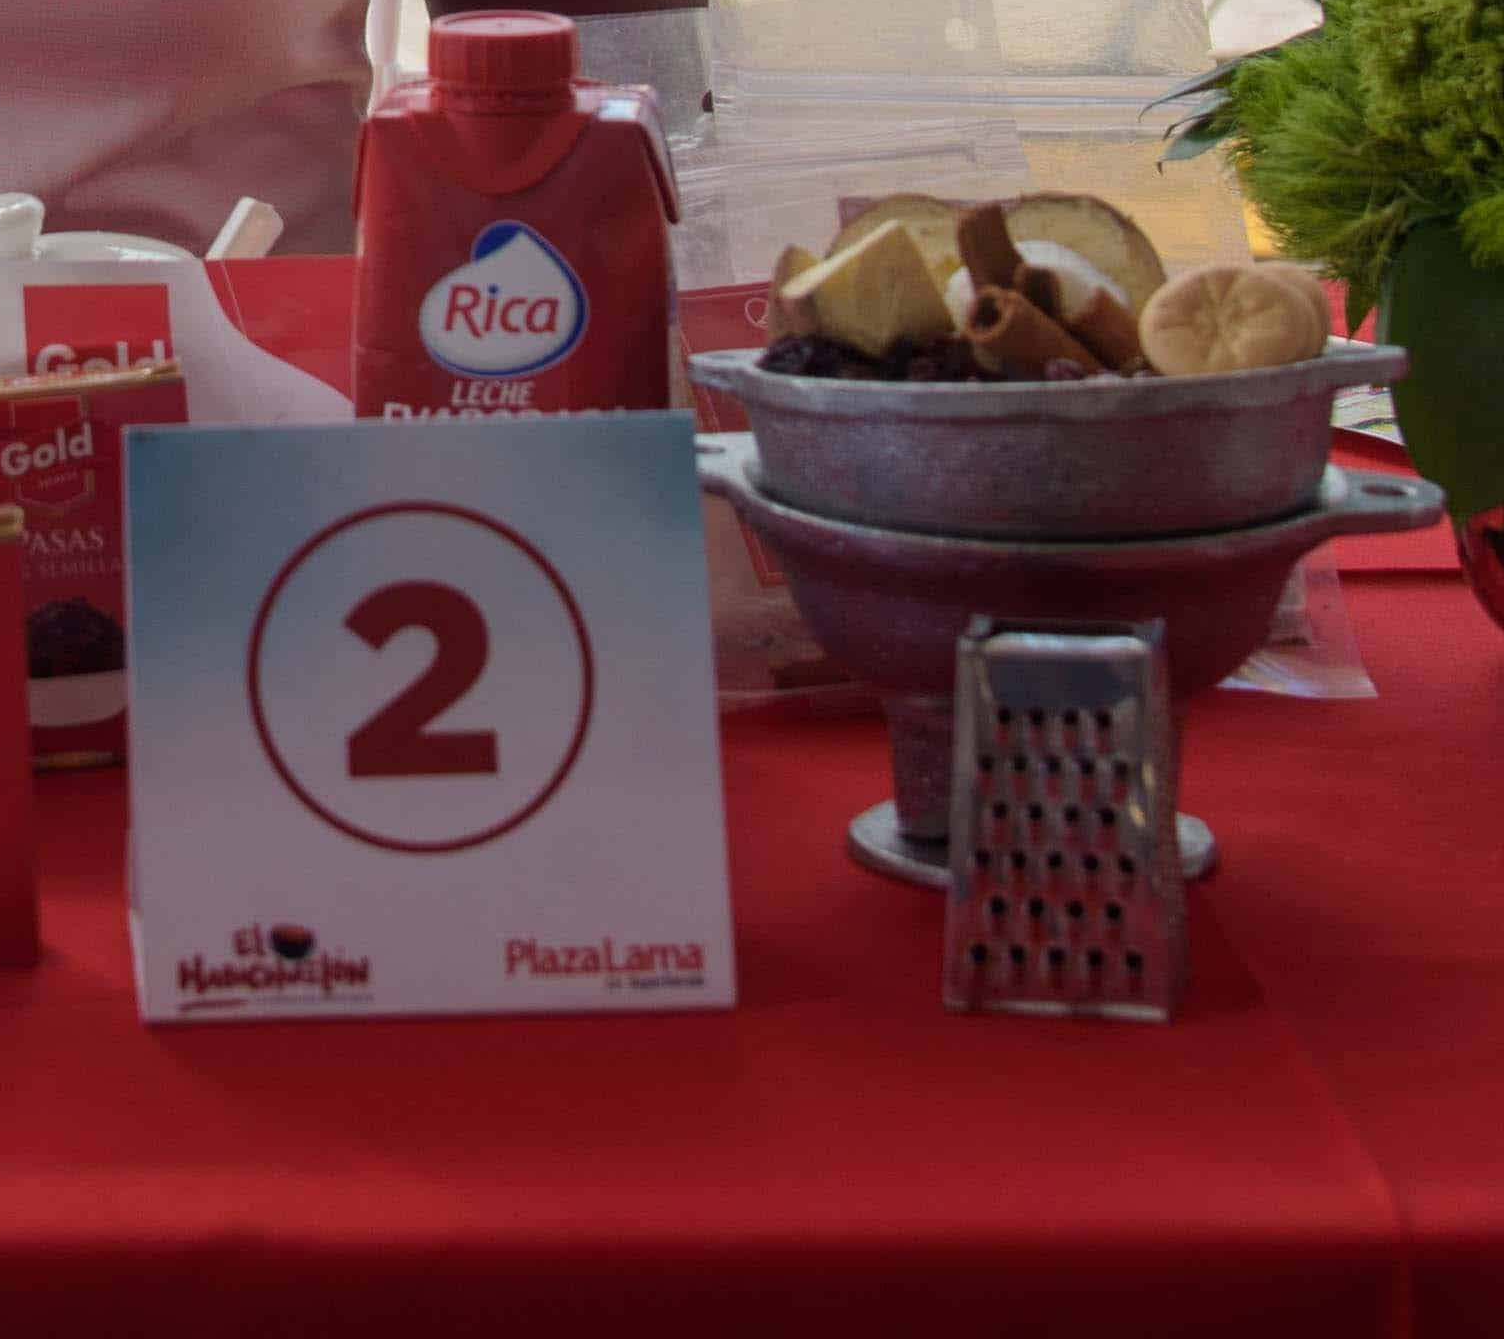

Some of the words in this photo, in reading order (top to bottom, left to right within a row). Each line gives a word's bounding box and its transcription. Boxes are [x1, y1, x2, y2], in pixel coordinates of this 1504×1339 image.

[444, 283, 559, 339] Rica
[451, 379, 536, 407] LECHE
[0, 422, 94, 477] Gold
[342, 580, 499, 779] 2
